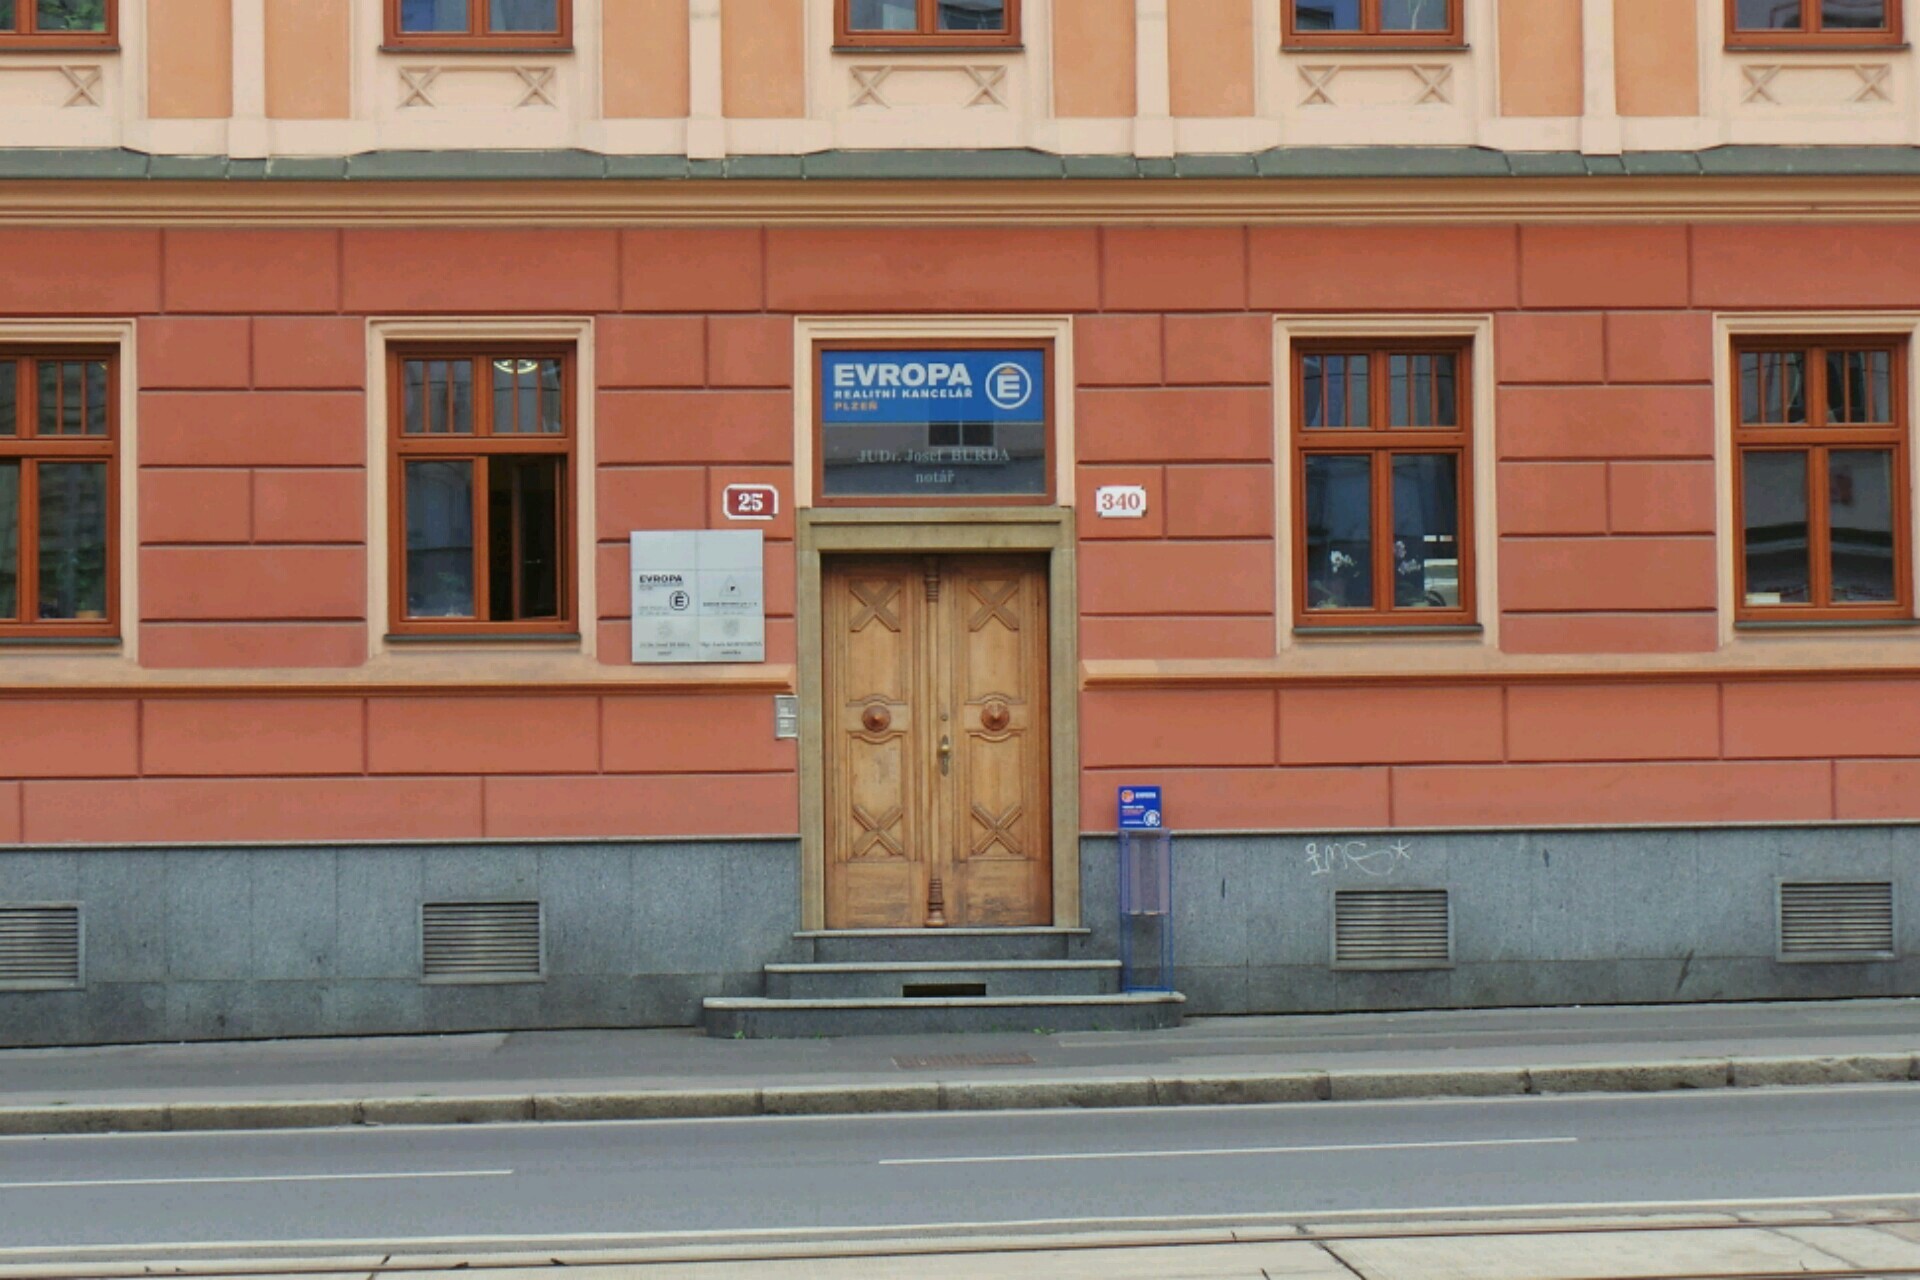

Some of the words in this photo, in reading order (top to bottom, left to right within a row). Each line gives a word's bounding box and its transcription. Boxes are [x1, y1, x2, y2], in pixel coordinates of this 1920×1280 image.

[833, 363, 972, 386] EVROPA
[834, 388, 896, 399] REALITNÍ
[902, 387, 973, 399] KANCELÁŘ
[834, 400, 878, 411] PLZEŇ
[857, 449, 901, 463] JUDr.
[904, 448, 942, 462] Josef
[951, 447, 1011, 462] BURDA
[915, 470, 955, 484] notář
[738, 492, 764, 511] 25
[1101, 493, 1141, 511] 340
[639, 574, 683, 583] EVROPA
